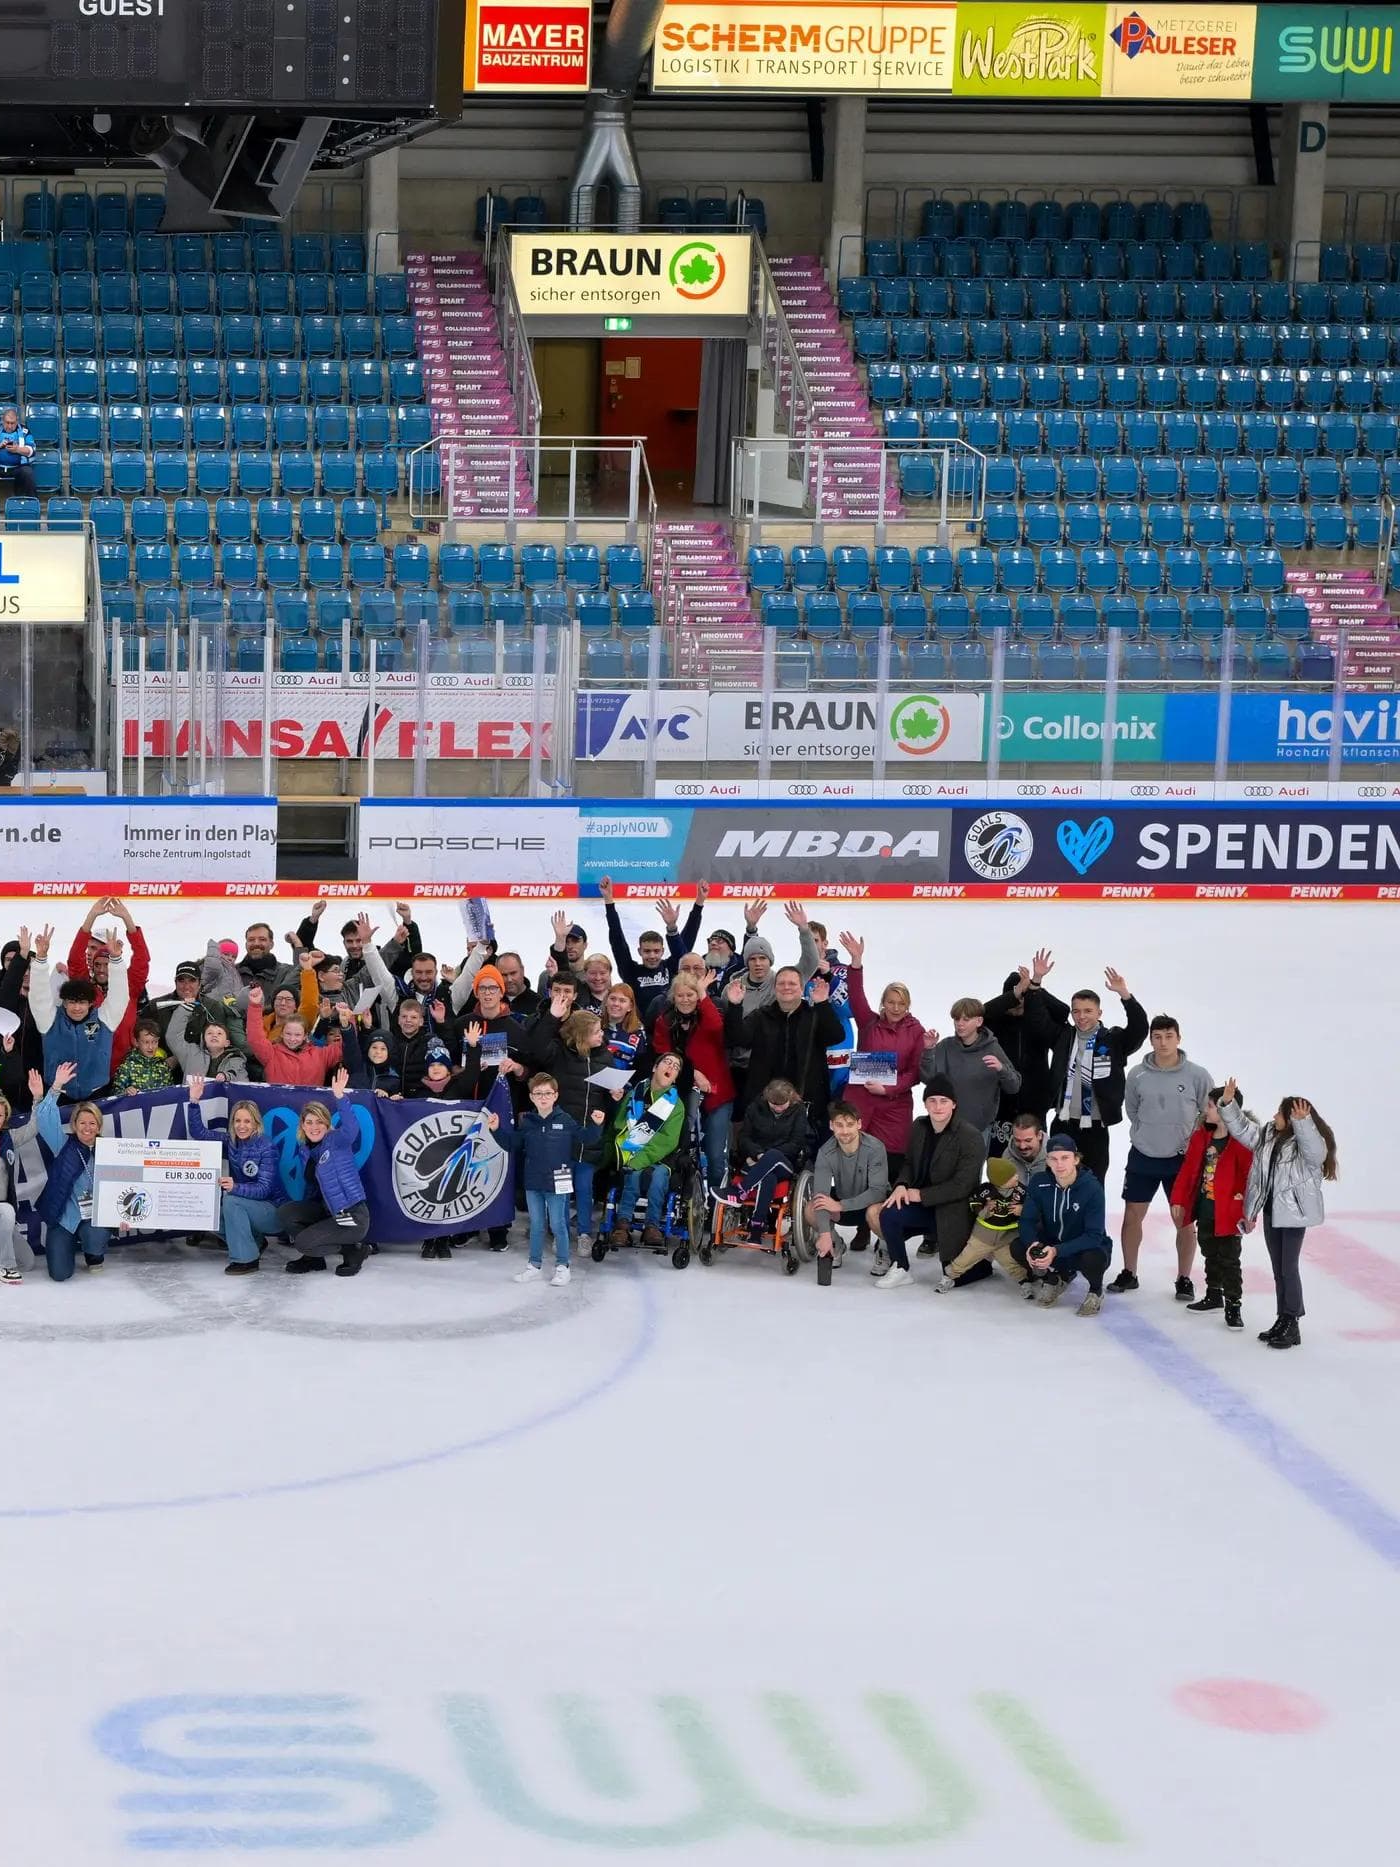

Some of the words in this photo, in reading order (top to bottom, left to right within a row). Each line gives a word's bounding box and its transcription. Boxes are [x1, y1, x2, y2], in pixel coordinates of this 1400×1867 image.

[78, 0, 166, 17] GUEST
[1157, 20, 1238, 32] METZGEREI
[482, 24, 584, 47] MAYER
[662, 23, 947, 54] SCHERMGRUPPE
[1121, 17, 1236, 56] PAULESER
[1278, 26, 1392, 75] SWI
[482, 53, 584, 67] BAUZENTRUM
[662, 58, 740, 75] LOGISTIK
[757, 60, 858, 76] TRANSPORT
[873, 60, 944, 76] SERVICE
[1206, 59, 1222, 70] das
[1300, 121, 1327, 153] D
[531, 249, 661, 276] BRAUN
[530, 286, 576, 302] sicher
[581, 288, 661, 305] entsorgen
[308, 675, 338, 685] Audi
[745, 702, 878, 730] BRAUN
[1023, 715, 1157, 741] Collomix
[123, 719, 351, 757] HANSA
[398, 720, 553, 758] FLEX
[709, 785, 742, 795] Audi
[823, 785, 854, 795] Audi
[937, 785, 969, 796] Audi
[1051, 786, 1084, 796] Audi
[1165, 786, 1197, 796] Audi
[1278, 786, 1310, 797] Audi
[123, 824, 182, 842] Immer
[185, 824, 201, 842] in
[205, 824, 238, 842] den
[243, 824, 277, 846] Play
[585, 821, 658, 835] #applyNOW
[967, 813, 1002, 842] GOALS
[369, 837, 546, 850] PORSCHE
[1136, 823, 1400, 870] SPENDEN
[123, 849, 161, 859] Porsche
[163, 849, 202, 859] Zentrum
[204, 849, 251, 861] Ingolstadt
[971, 853, 992, 875] FOR
[991, 863, 1017, 878] KIDS
[396, 1114, 465, 1167] GOALS
[165, 1171, 183, 1180] EUR
[184, 1171, 213, 1181] 30.000
[401, 1188, 438, 1220] FOR
[442, 1184, 486, 1220] KIDS
